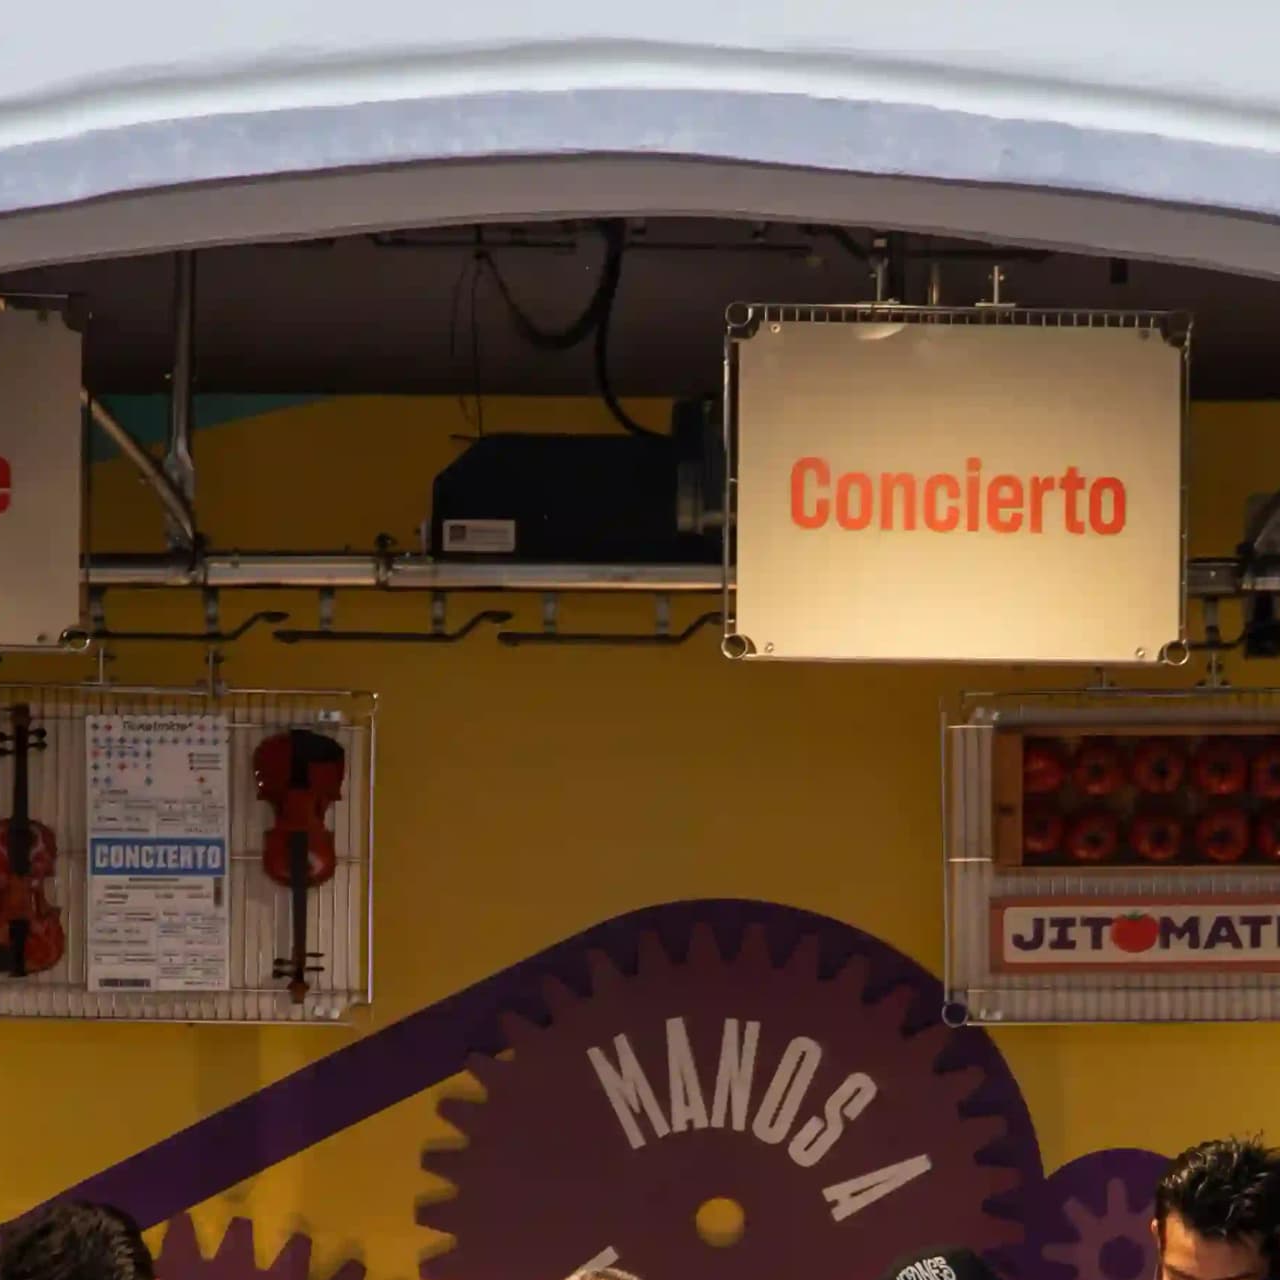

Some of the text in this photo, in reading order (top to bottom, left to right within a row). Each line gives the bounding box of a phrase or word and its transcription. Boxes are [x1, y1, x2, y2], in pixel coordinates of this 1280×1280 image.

[790, 456, 1127, 536] Concierto
[94, 843, 222, 869] CONCIERTO
[586, 1016, 933, 1223] MANOS A
